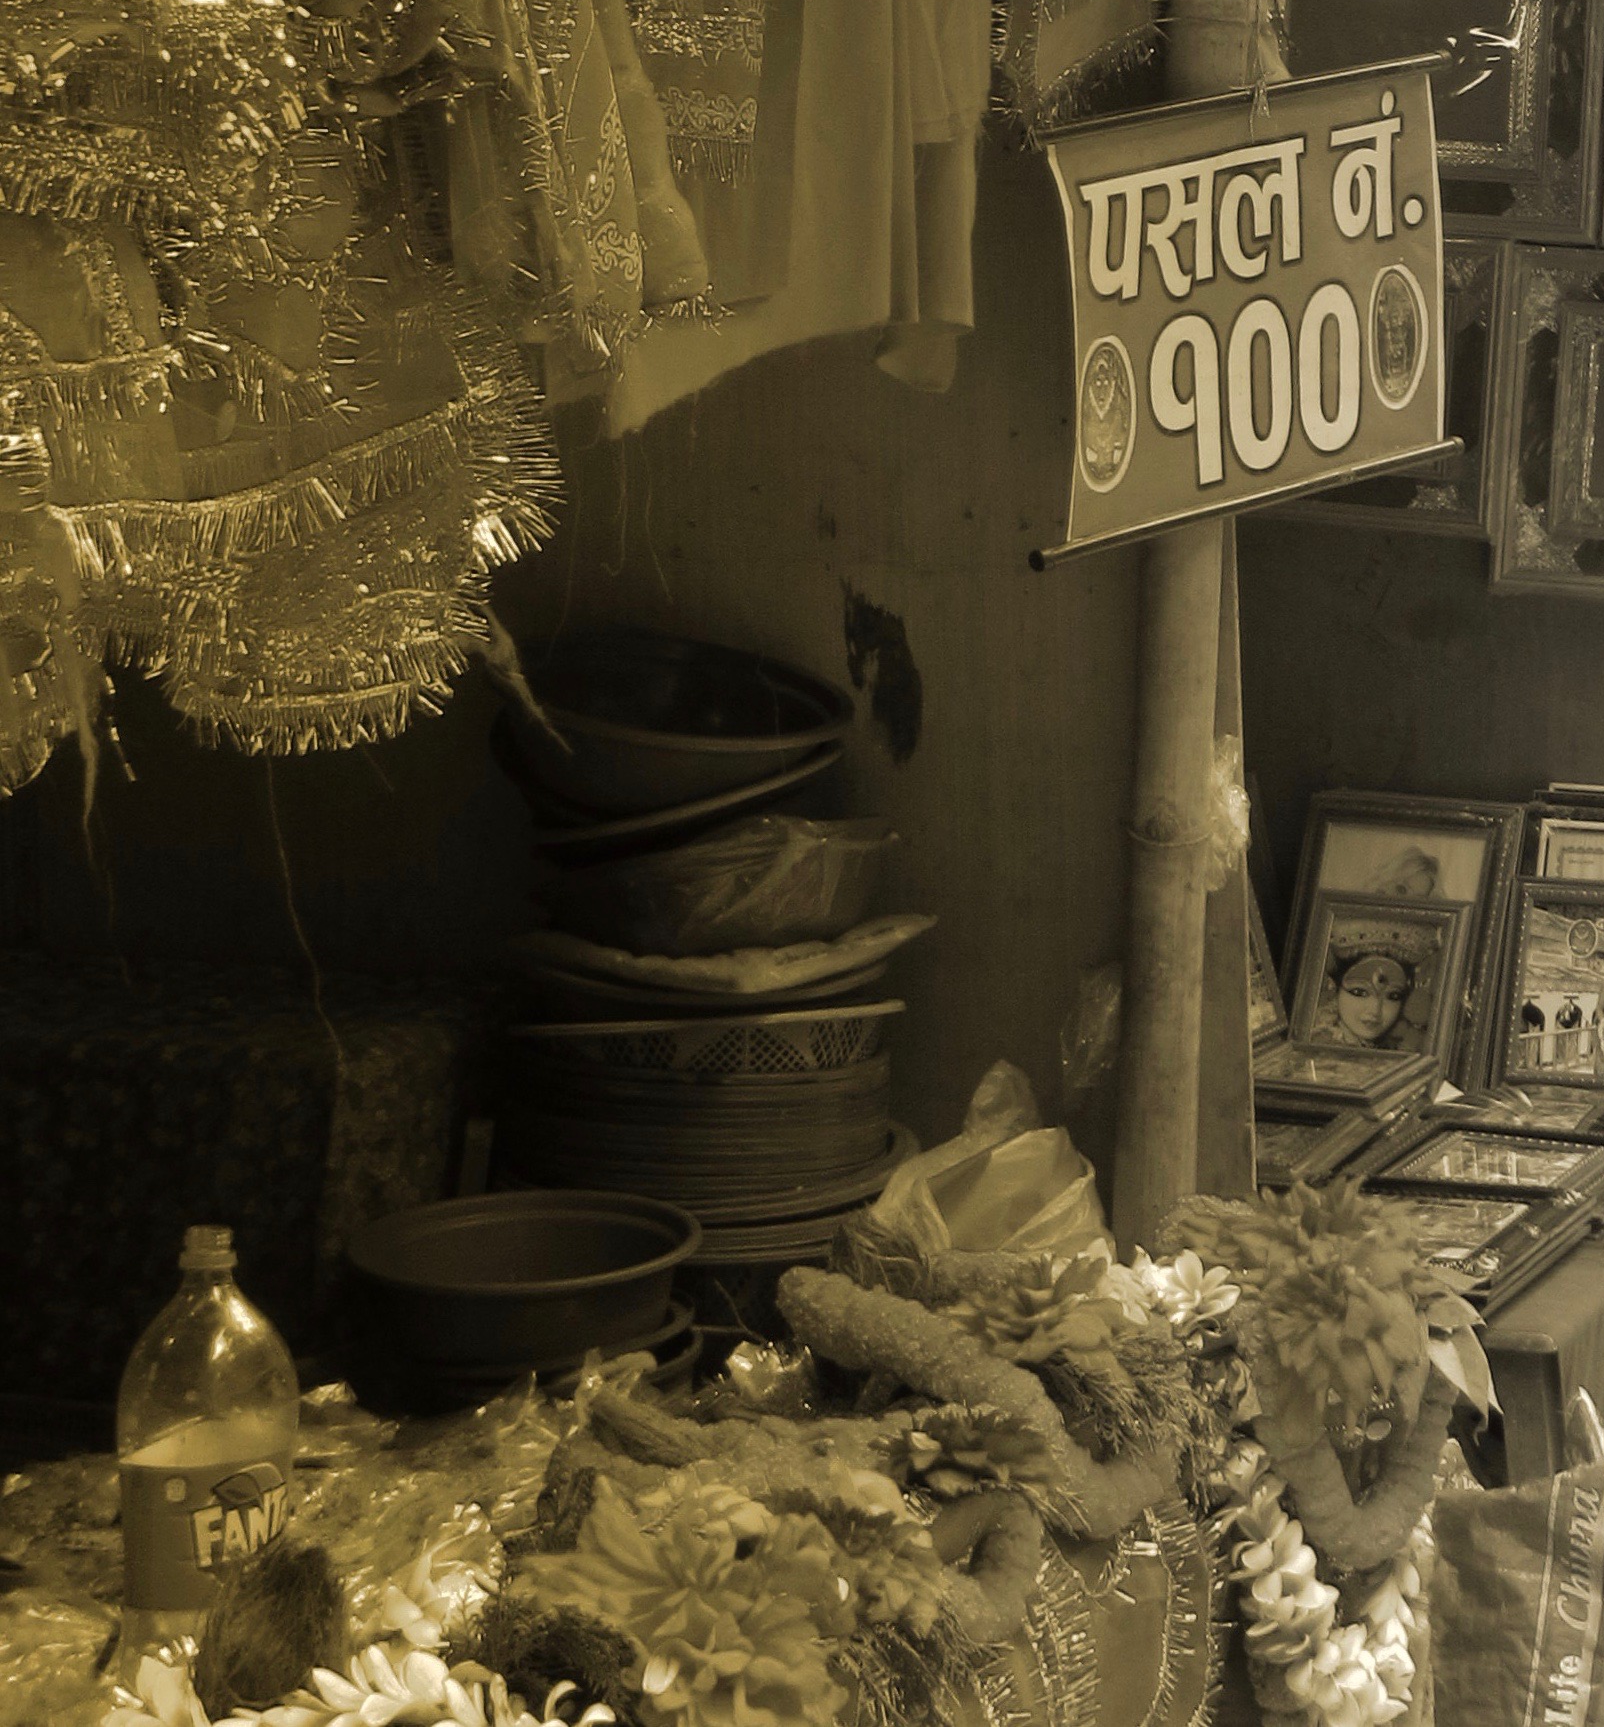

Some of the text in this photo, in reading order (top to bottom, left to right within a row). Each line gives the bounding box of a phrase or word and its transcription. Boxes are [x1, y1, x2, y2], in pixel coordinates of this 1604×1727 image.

[1079, 90, 1424, 301] पसल नं.
[1150, 284, 1361, 486] १००
[193, 1486, 286, 1569] FANT
[1544, 1654, 1583, 1727] Life
